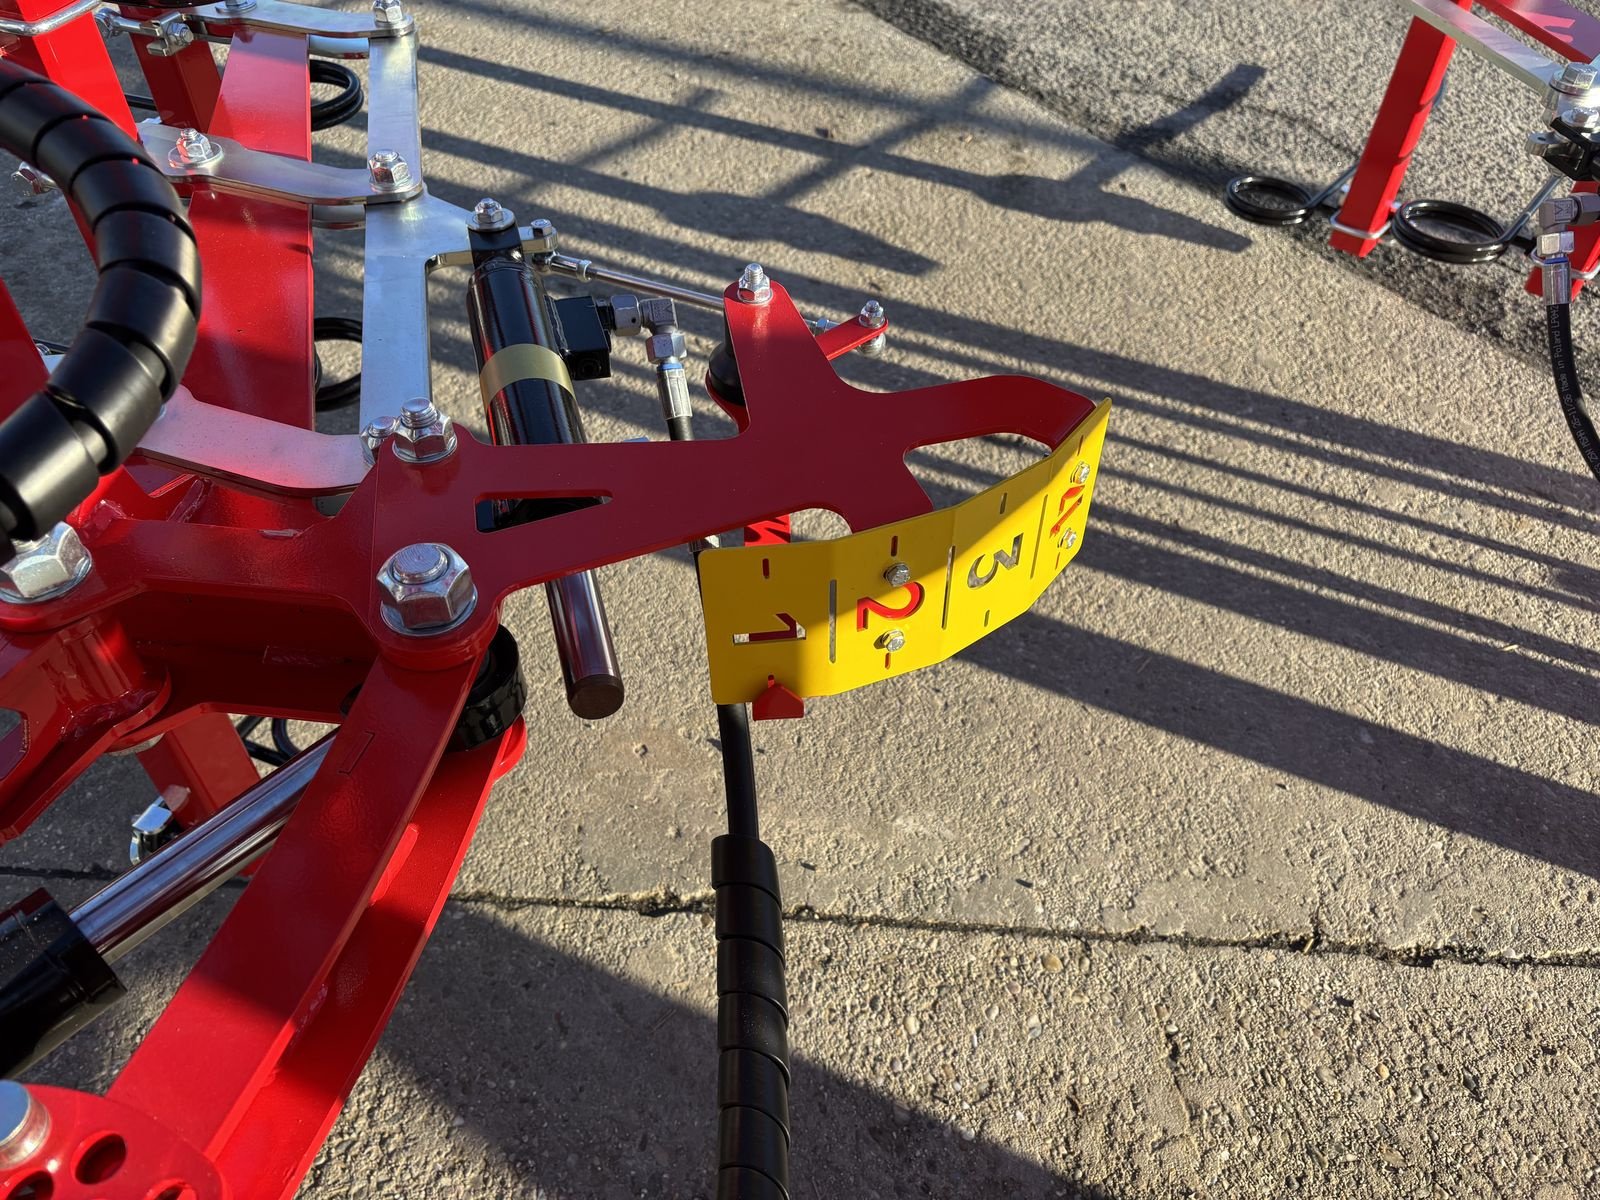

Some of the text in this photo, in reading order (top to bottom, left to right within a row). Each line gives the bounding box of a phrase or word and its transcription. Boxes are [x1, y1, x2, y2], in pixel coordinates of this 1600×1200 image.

[1552, 331, 1563, 359] Poland
[1558, 360, 1565, 369] in
[1559, 373, 1570, 392] Made
[967, 532, 1024, 588] 3
[856, 581, 924, 632] 2
[733, 613, 806, 646] 1
